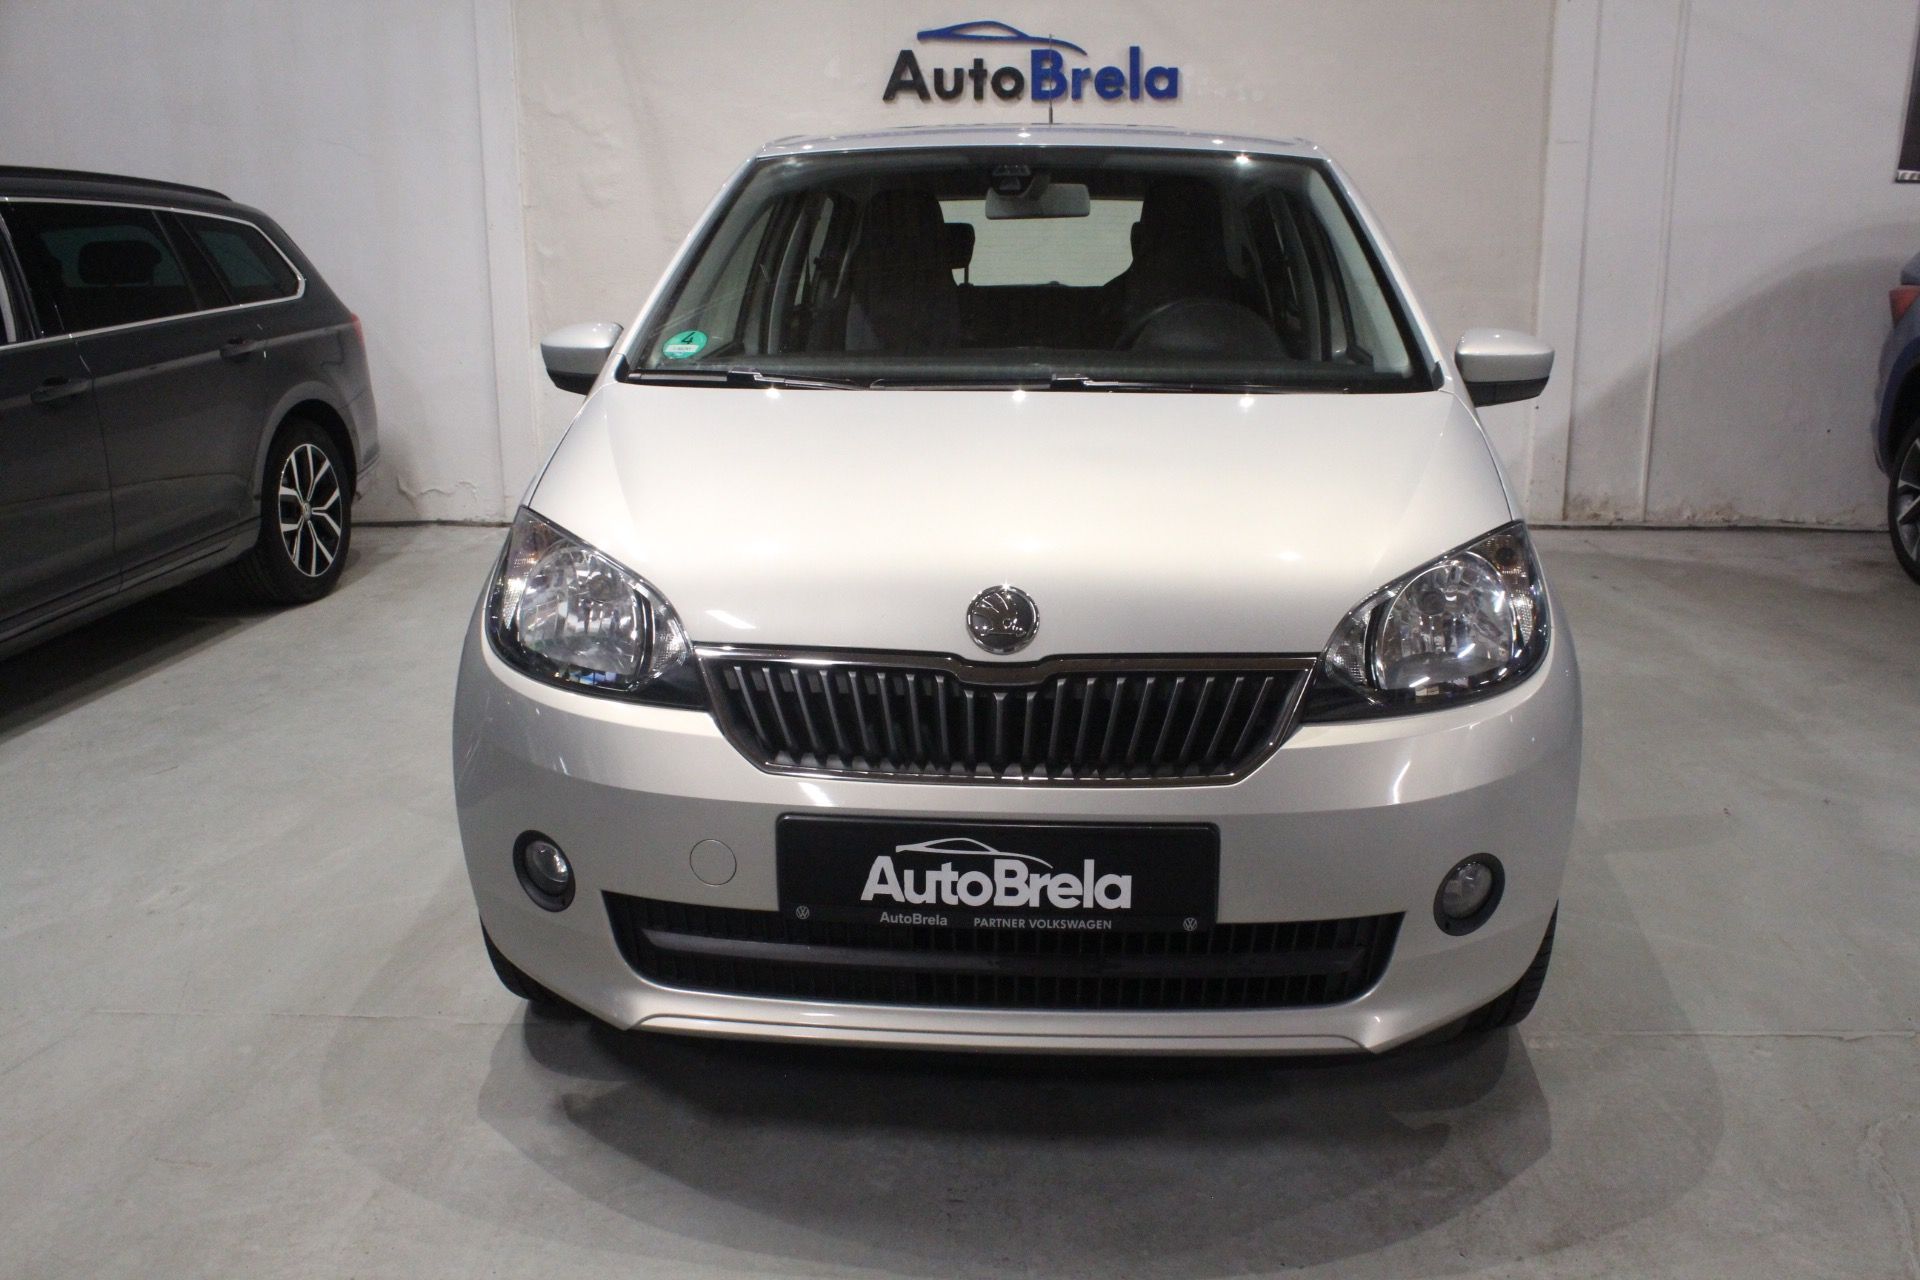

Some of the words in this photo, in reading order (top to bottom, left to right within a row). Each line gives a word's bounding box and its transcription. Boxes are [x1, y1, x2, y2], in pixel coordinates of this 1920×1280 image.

[883, 46, 1178, 100] AutoBrela
[681, 331, 696, 344] 4
[860, 855, 1132, 909] AutoBrela
[880, 911, 948, 926] AutoBrela
[974, 917, 1026, 929] PARTNER
[1028, 919, 1112, 930] VOLKSWAGEN
